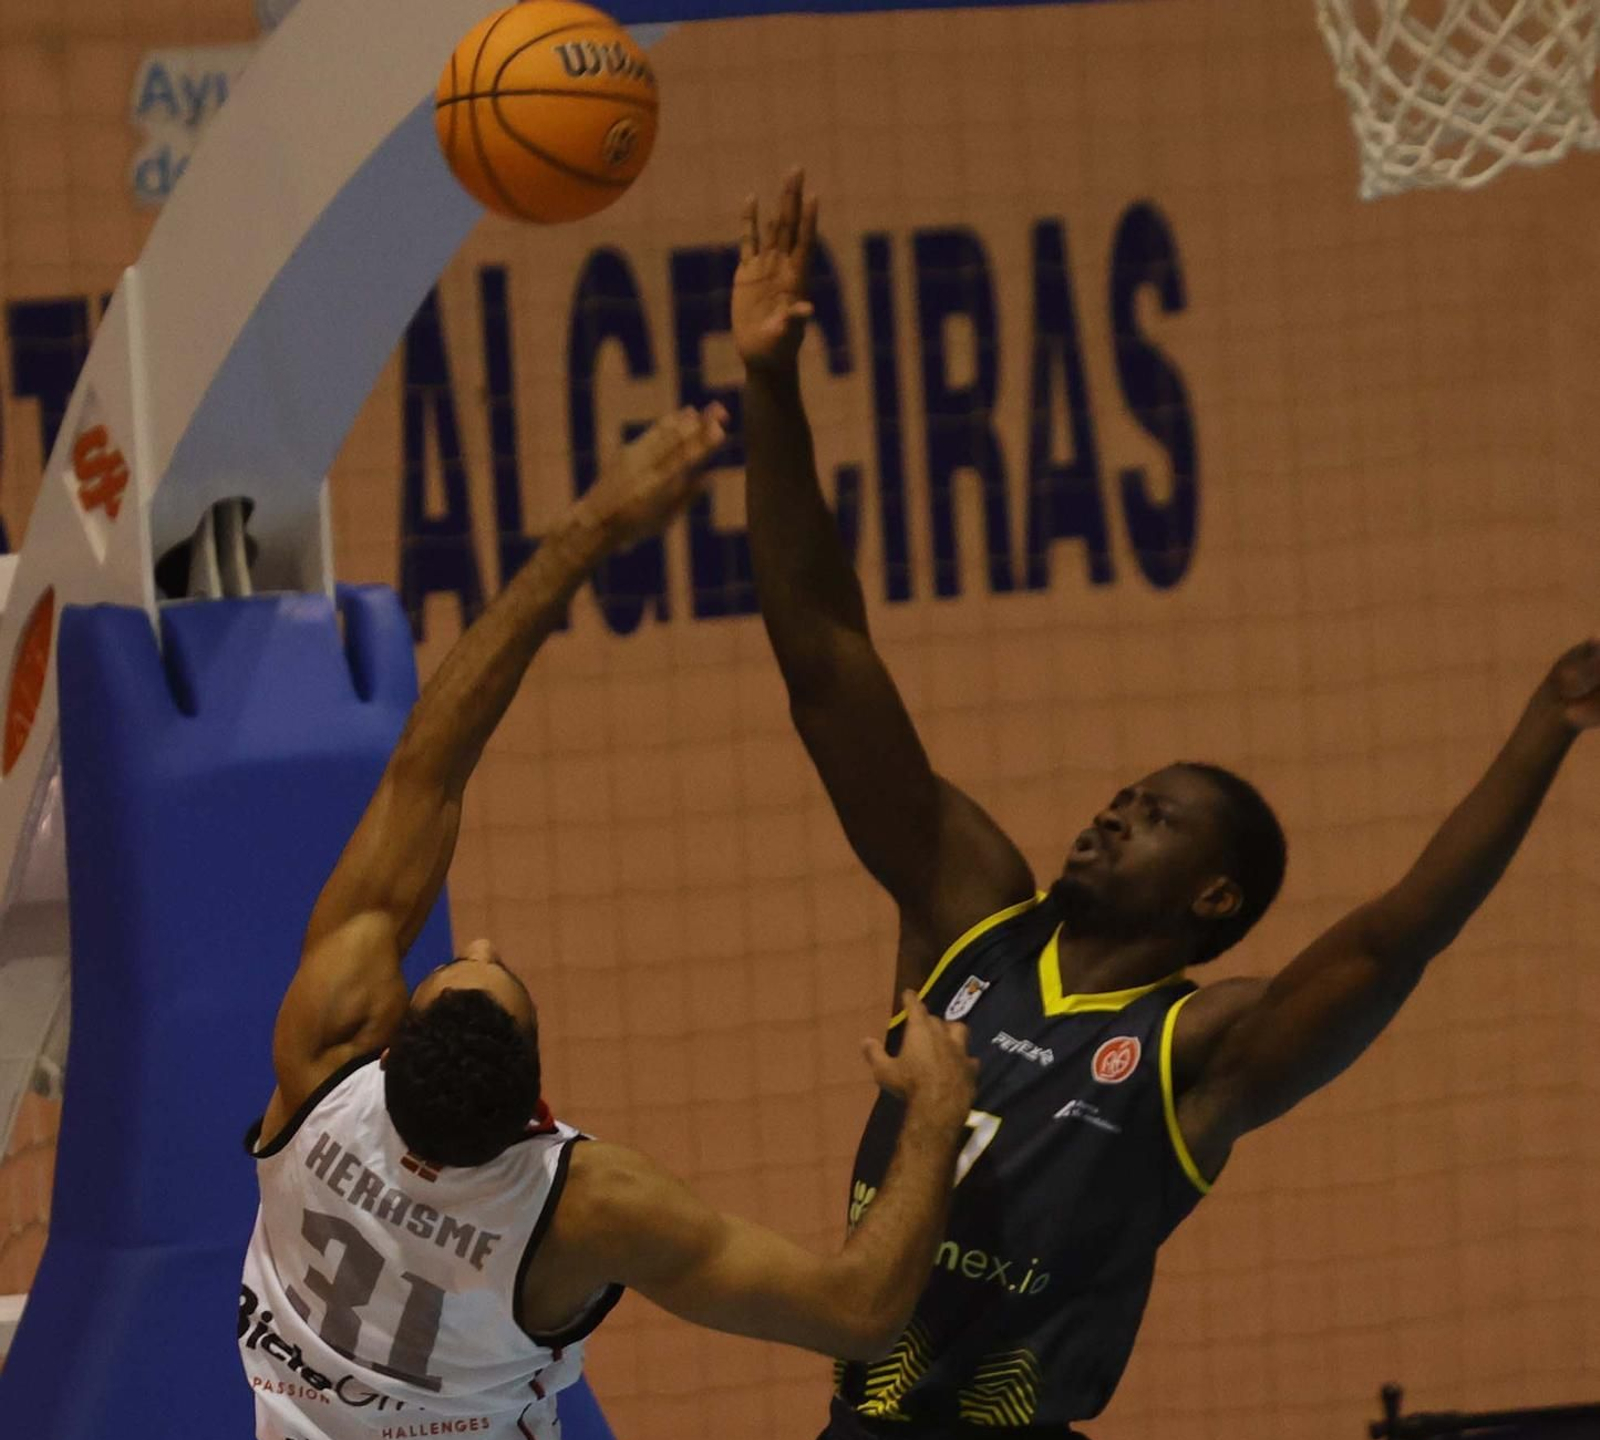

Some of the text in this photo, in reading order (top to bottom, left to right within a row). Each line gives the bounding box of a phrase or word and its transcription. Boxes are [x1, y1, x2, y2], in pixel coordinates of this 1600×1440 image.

[304, 1131, 502, 1272] HERASME
[285, 1207, 446, 1392] 31
[252, 1376, 331, 1405] PASSION
[382, 1417, 490, 1440] HALLENGES
